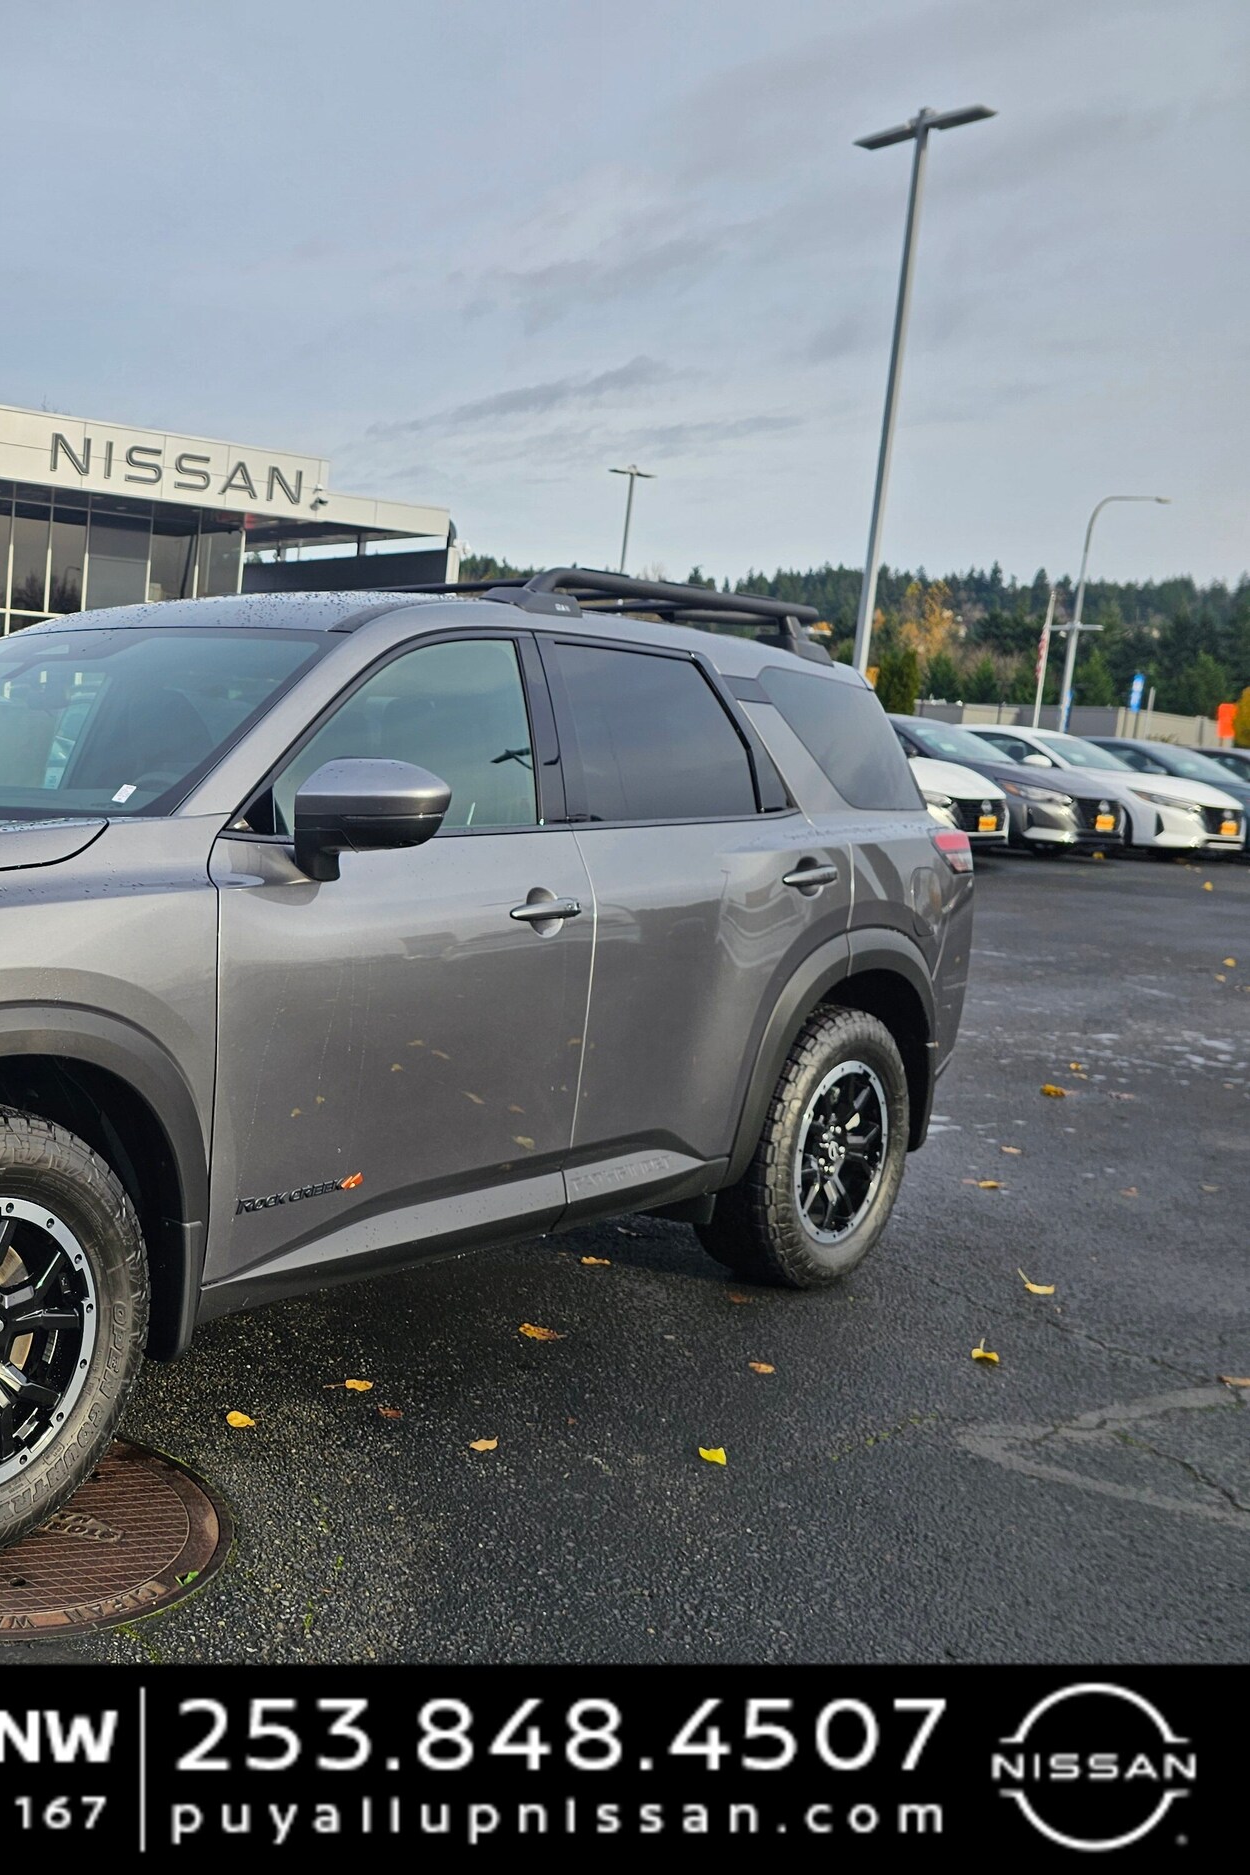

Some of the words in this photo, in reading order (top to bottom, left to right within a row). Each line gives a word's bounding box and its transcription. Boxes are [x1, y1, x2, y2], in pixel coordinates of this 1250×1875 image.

[50, 432, 303, 505] NISSAN
[235, 1191, 288, 1215] ROCK
[289, 1178, 344, 1203] CREEK
[99, 1301, 128, 1401] OPEN
[64, 1586, 159, 1624] CLEAN
